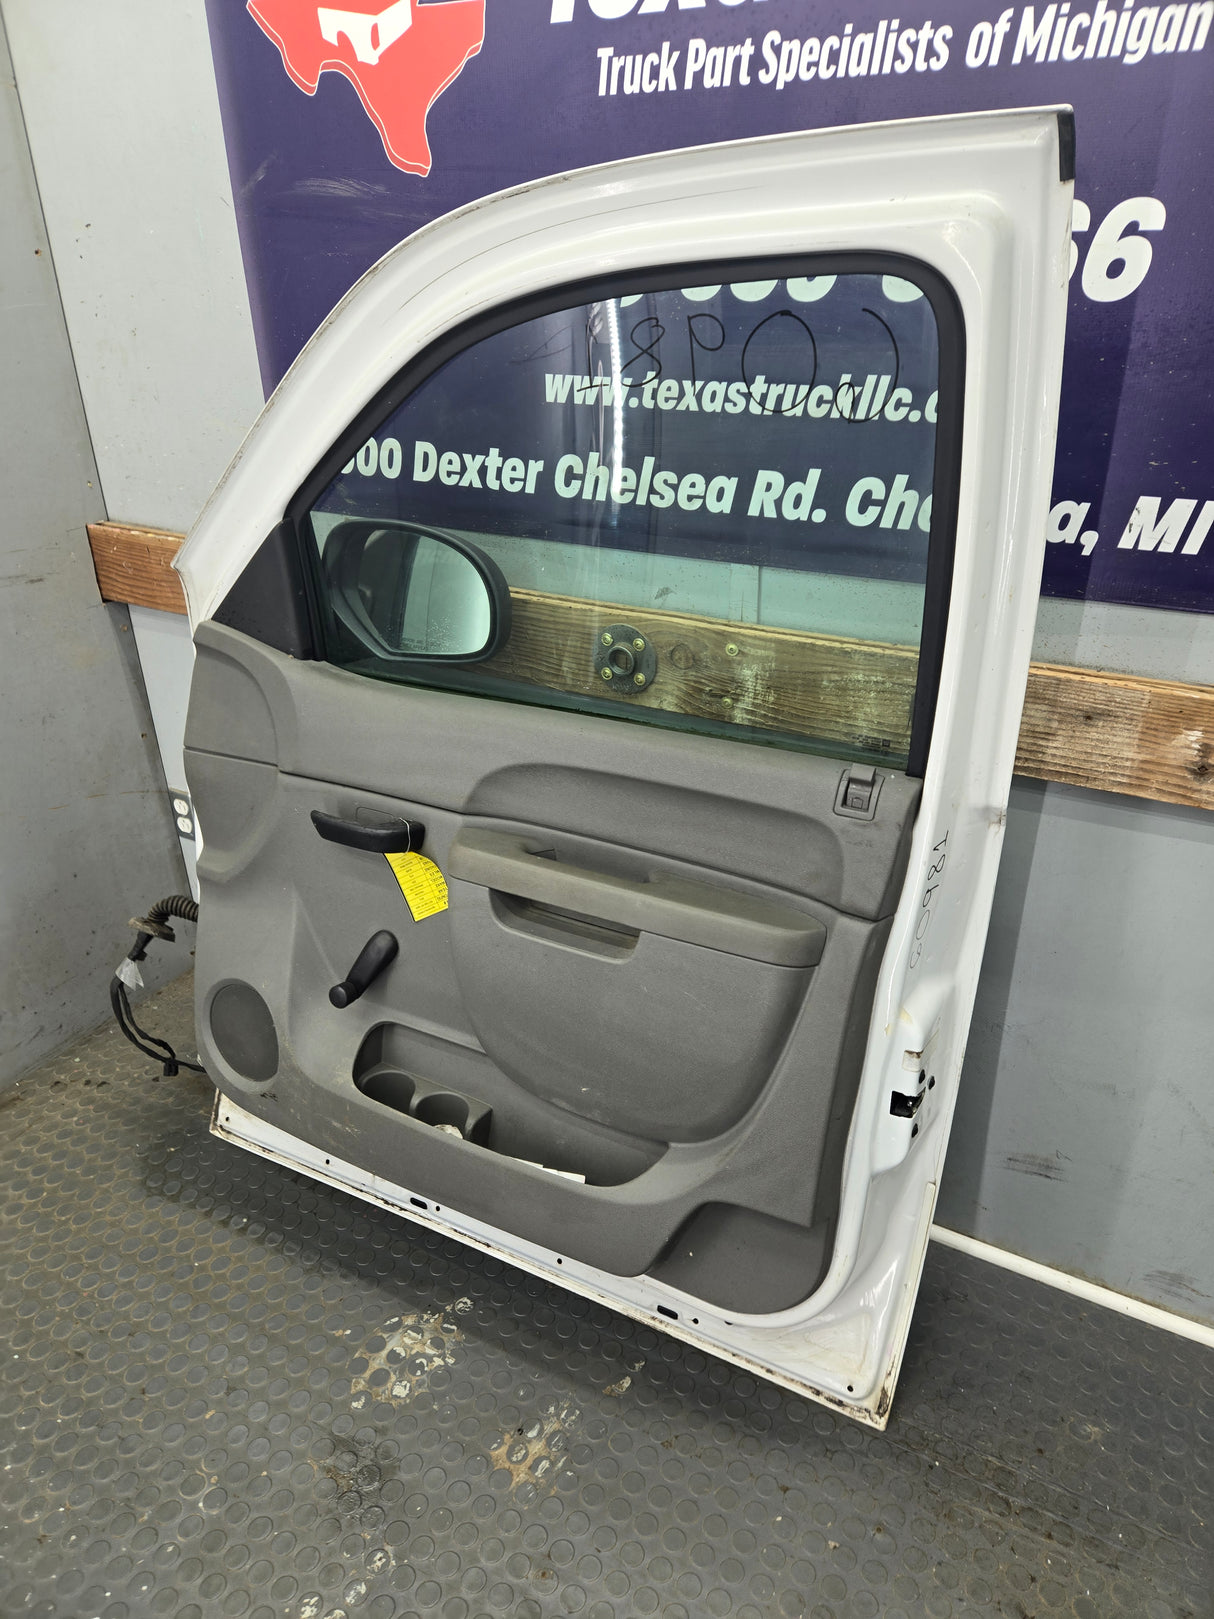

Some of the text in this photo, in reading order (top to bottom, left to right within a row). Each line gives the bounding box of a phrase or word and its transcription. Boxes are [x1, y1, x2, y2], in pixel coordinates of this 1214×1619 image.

[597, 0, 1214, 97] Truck Part Specialists of Michigan
[412, 440, 544, 495] Dexter
[554, 451, 739, 515] Chelsea
[747, 468, 827, 524] Rd.
[1117, 495, 1214, 556] MI
